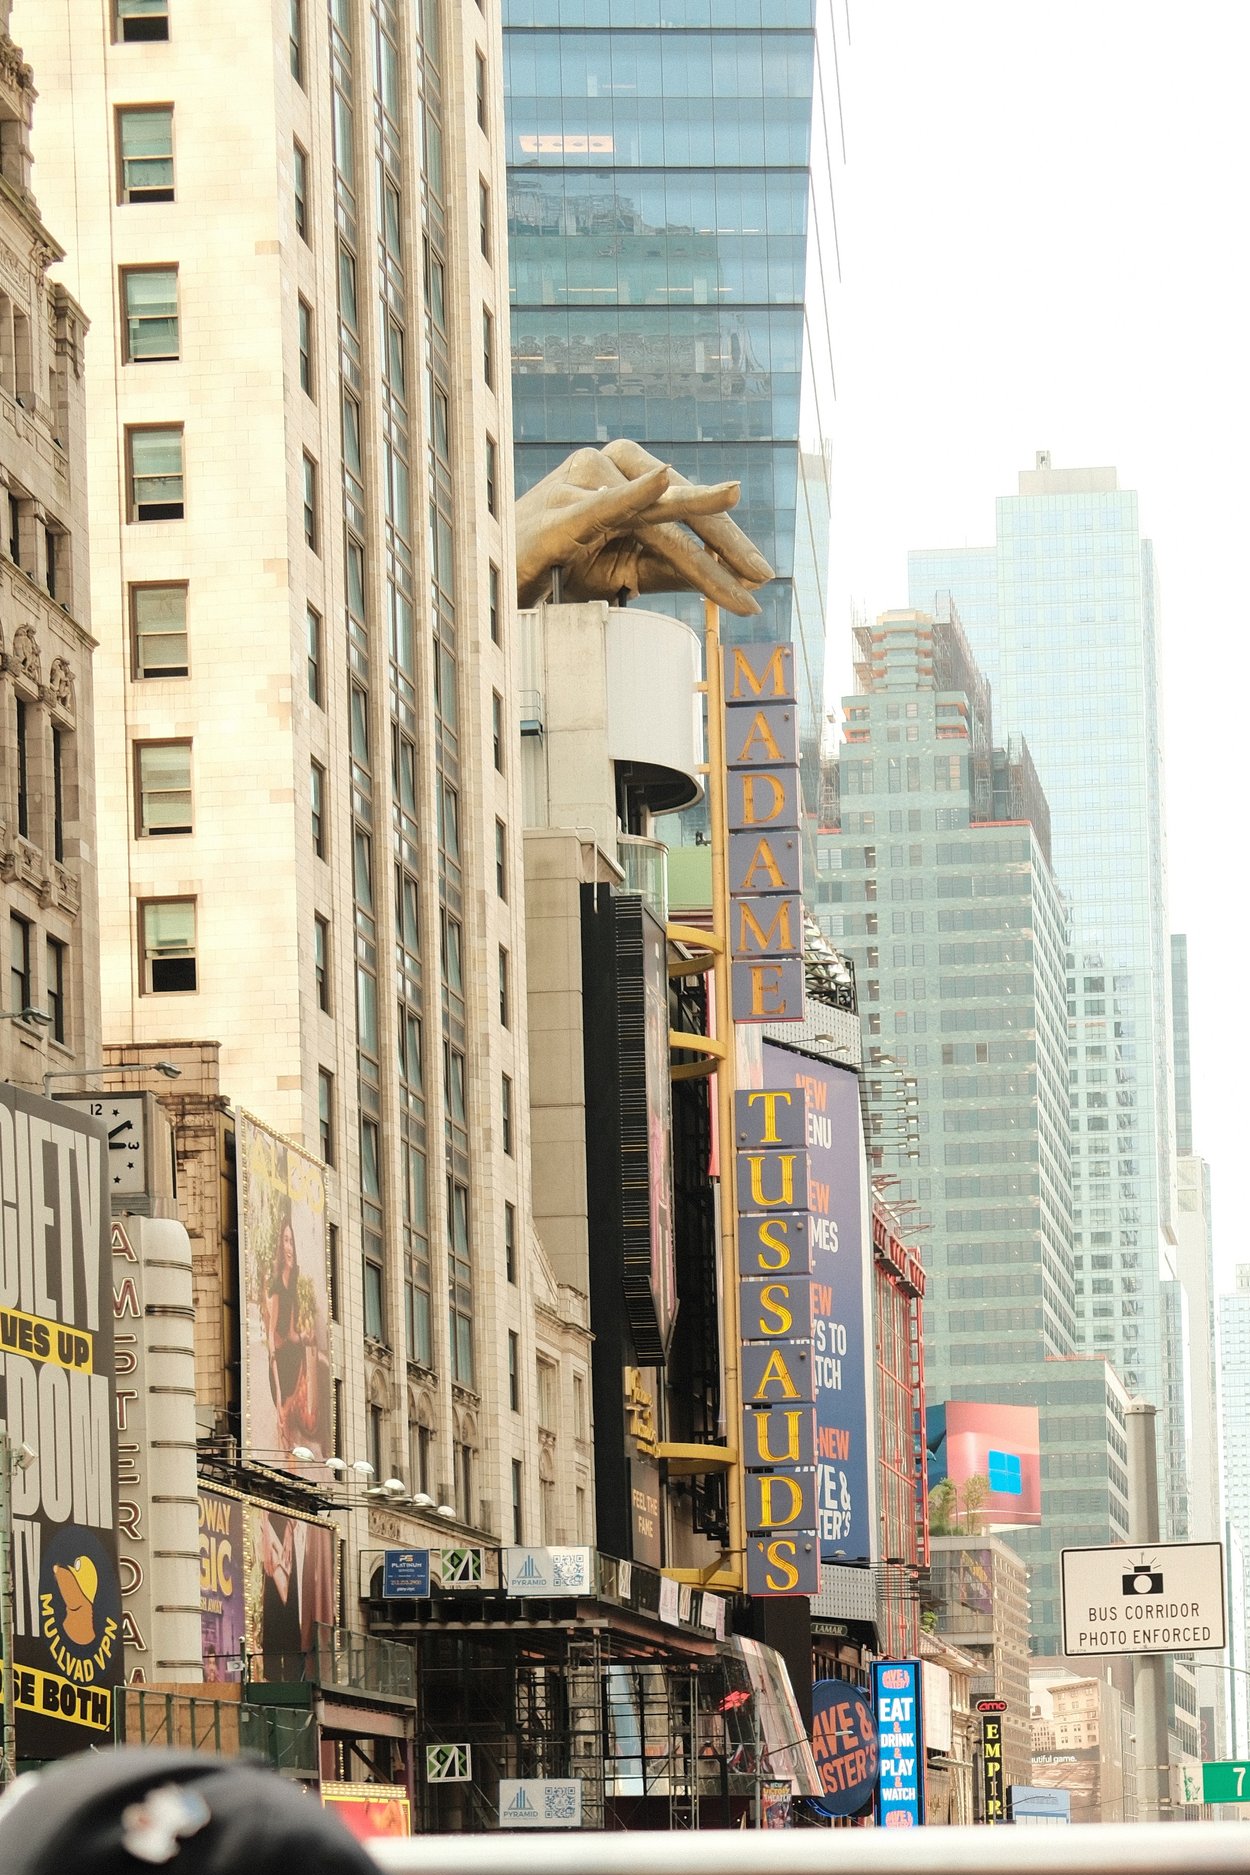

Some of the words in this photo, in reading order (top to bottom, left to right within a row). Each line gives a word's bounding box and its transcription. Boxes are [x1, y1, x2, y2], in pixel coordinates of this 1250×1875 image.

[731, 646, 795, 1017] MADAME
[90, 1103, 103, 1116] 12
[810, 1216, 839, 1253] MES
[57, 1329, 90, 1367] UP
[747, 1091, 803, 1592] TUSSAUD'S
[829, 1321, 847, 1356] TO
[632, 1488, 647, 1511] FEEL
[646, 1495, 658, 1517] THE
[638, 1516, 654, 1538] FAME
[818, 1509, 851, 1542] TER'S
[511, 1578, 547, 1586] PYRAMID
[1088, 1606, 1118, 1622] BUS
[1125, 1602, 1200, 1621] CORRIDOR
[40, 1592, 95, 1682] MULLVAD
[93, 1616, 118, 1671] VPN
[814, 1624, 843, 1635] LAMAR
[1079, 1630, 1127, 1647] PHOTO
[1133, 1626, 1211, 1645] ENFORCED
[42, 1677, 108, 1726] BOTH
[879, 1697, 914, 1722] EAT
[979, 1701, 1006, 1711] amc
[855, 1700, 875, 1741] &
[893, 1721, 902, 1733] &
[880, 1733, 915, 1748] DRINK
[893, 1748, 902, 1759] &
[1053, 1756, 1078, 1765] game.
[881, 1759, 915, 1777] PLAY
[894, 1776, 903, 1788] &
[1232, 1767, 1246, 1797] 7
[882, 1787, 916, 1801] WATCH
[503, 1810, 539, 1818] PYRAMID
